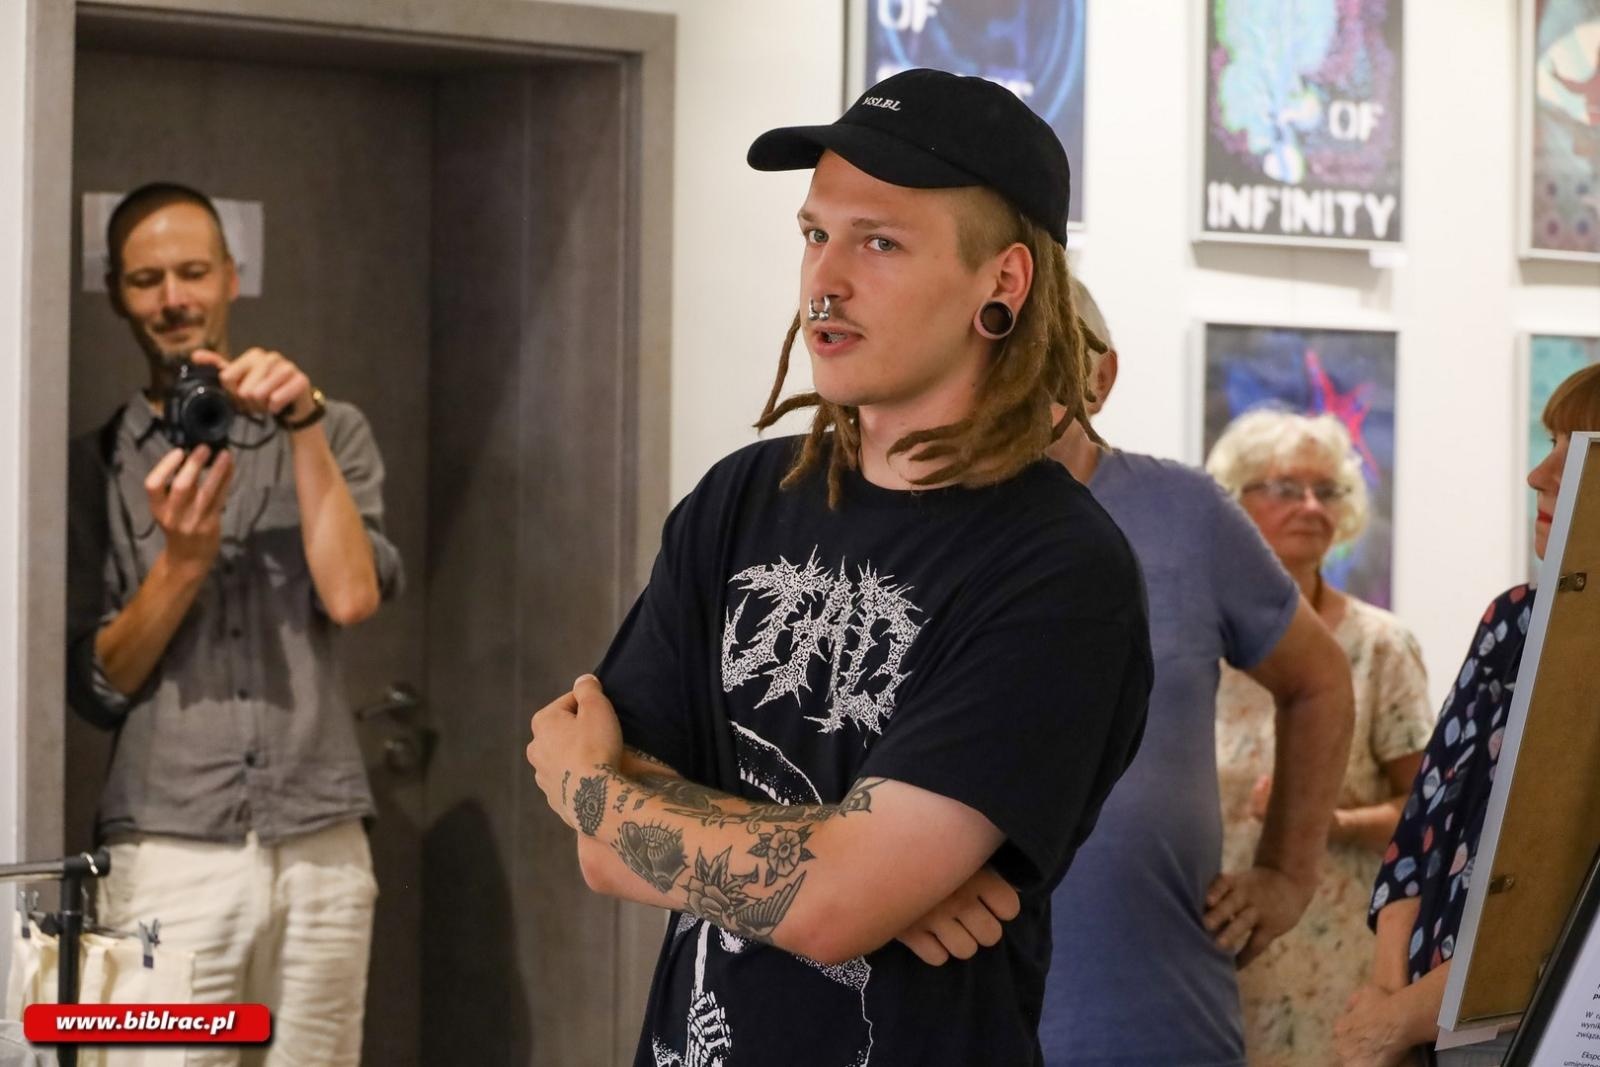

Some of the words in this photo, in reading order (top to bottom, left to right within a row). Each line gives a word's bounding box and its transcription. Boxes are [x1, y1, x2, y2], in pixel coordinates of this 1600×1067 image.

[877, 0, 940, 32] OF
[1328, 101, 1384, 142] OF
[1207, 182, 1397, 238] INFINITY
